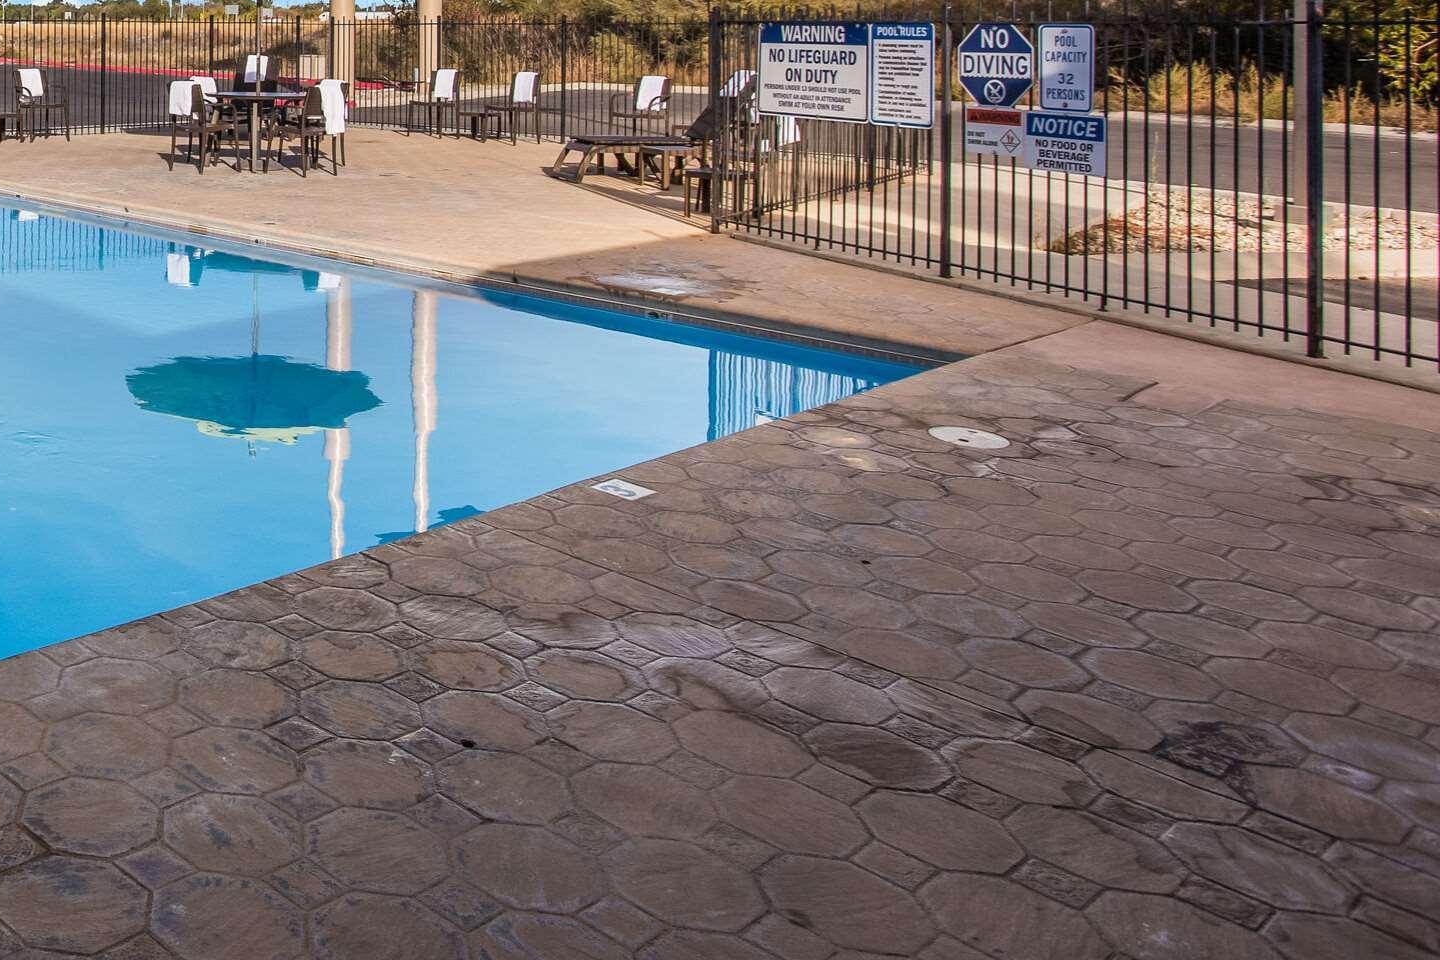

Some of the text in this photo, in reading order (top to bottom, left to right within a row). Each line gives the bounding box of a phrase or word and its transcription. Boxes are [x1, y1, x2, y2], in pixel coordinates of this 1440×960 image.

[781, 25, 845, 43] WARNING
[877, 26, 927, 37] POOL RULES
[981, 29, 1009, 49] NO
[1054, 35, 1078, 47] POOL
[769, 48, 857, 66] NO LIFEGUARD
[1045, 51, 1087, 63] CAPACITY
[963, 55, 1028, 75] DIVING
[785, 67, 838, 84] ON DUTY
[1058, 73, 1074, 85] 32
[1046, 88, 1085, 101] PERSONS
[1032, 117, 1098, 138] NOTICE
[1035, 139, 1094, 152] NO FOOD OR
[1039, 150, 1090, 163] BEVERAGE
[1036, 159, 1092, 173] PERMITTED
